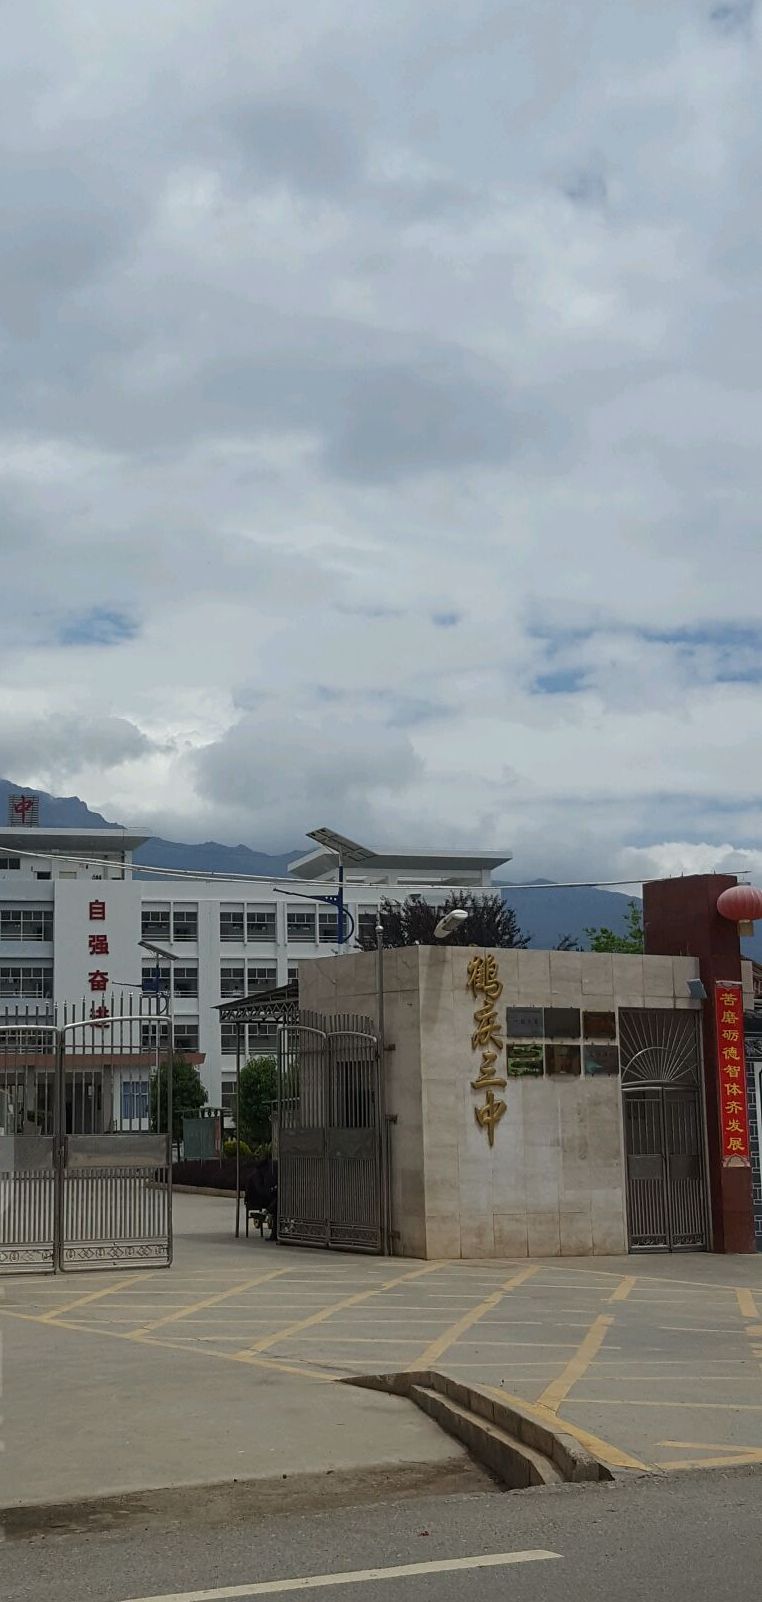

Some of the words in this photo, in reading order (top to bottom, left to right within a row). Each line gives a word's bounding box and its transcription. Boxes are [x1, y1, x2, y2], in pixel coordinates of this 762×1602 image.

[15, 795, 33, 823] 中
[719, 993, 745, 1151] 苦磨砺德智体齐发展
